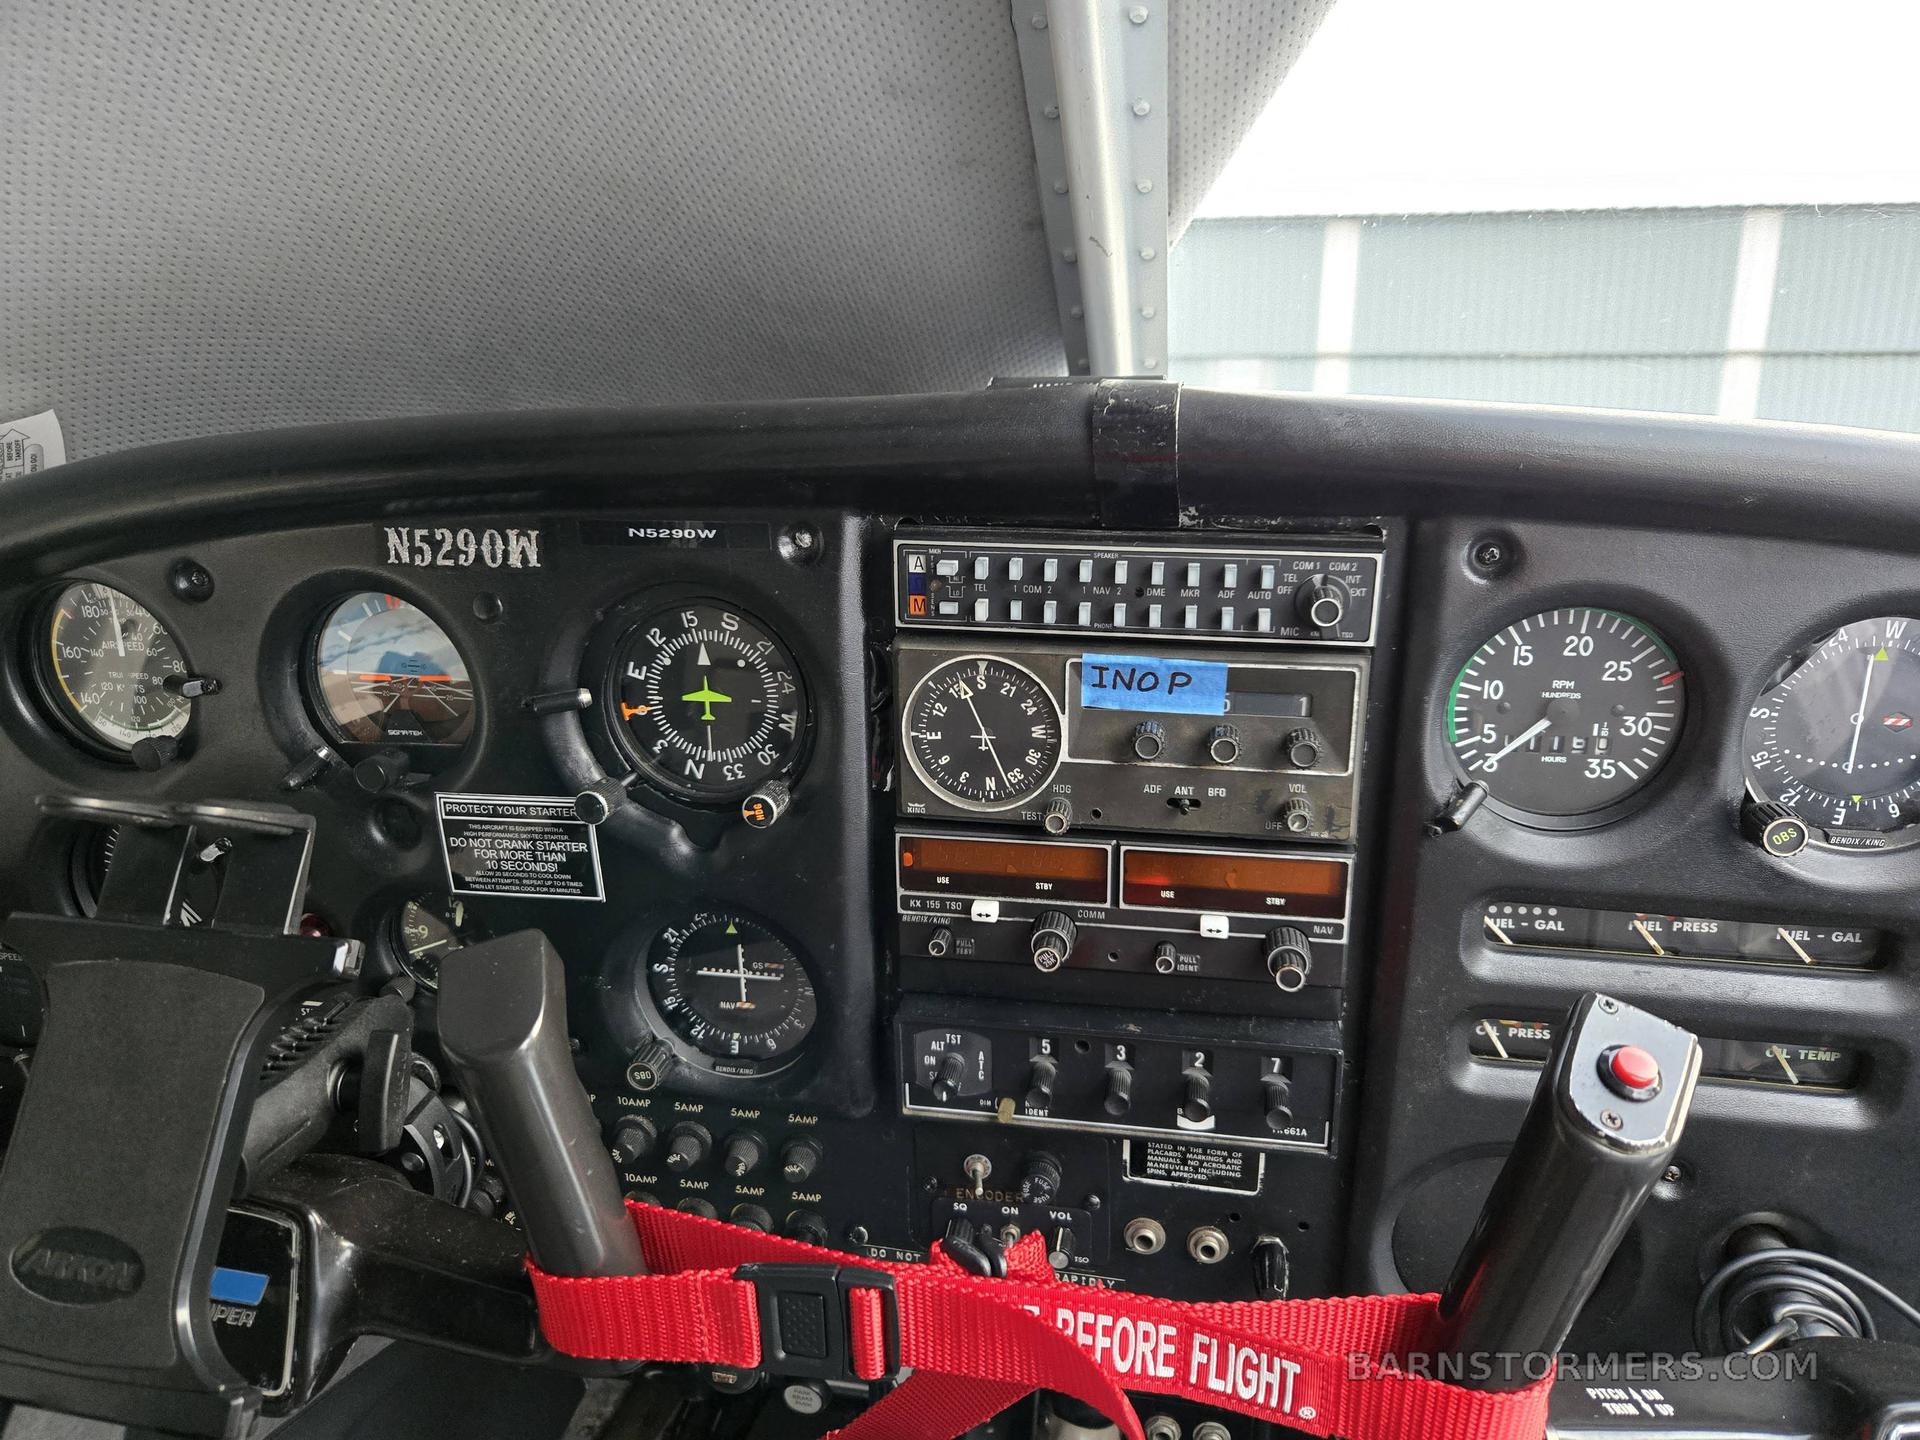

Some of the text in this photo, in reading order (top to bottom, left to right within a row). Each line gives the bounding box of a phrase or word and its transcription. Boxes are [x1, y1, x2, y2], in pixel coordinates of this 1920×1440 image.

[628, 527, 717, 539] N5290W
[384, 527, 541, 568] N5290W
[913, 557, 924, 571] A
[1293, 561, 1314, 570] COM
[1329, 562, 1357, 571] COM 2
[1283, 574, 1298, 582] TEL
[1345, 575, 1362, 584] INT
[974, 584, 988, 592] TEL
[1023, 585, 1042, 594] COM
[1047, 586, 1052, 594] 2
[1093, 587, 1111, 595] NAV
[1117, 587, 1122, 596] 2
[1146, 588, 1166, 597] DME
[1180, 589, 1200, 598] MKR
[1277, 586, 1293, 594] OFF
[1351, 588, 1367, 597] EXT
[1218, 590, 1235, 599] ADF
[1248, 591, 1271, 600] AUTO
[913, 598, 926, 612] M
[82, 606, 100, 618] 180
[680, 610, 698, 628] 15
[721, 612, 740, 631] S
[1280, 627, 1299, 636] MIC
[1885, 620, 1907, 640] W
[646, 628, 667, 648] 12
[756, 639, 775, 655] 21
[1563, 636, 1594, 656] 20
[62, 647, 81, 659] 160
[1513, 646, 1534, 666] 15
[627, 661, 647, 680] E
[1602, 661, 1633, 682] 25
[977, 676, 986, 689] S
[1091, 666, 1193, 695] INOP
[1552, 680, 1575, 690] RPM
[1000, 683, 1017, 698] 21
[1482, 680, 1504, 700] 10
[1541, 691, 1581, 700] HUNDREDS
[81, 692, 100, 704] 140
[932, 702, 948, 717] 12
[1020, 699, 1038, 716] 24
[1750, 707, 1770, 719] S
[778, 712, 798, 740] W
[1031, 725, 1046, 739] W
[1620, 716, 1653, 736] 30
[926, 731, 941, 740] E
[1482, 724, 1497, 743] 5
[1751, 751, 1772, 770] 15
[684, 758, 706, 779] N
[1584, 758, 1616, 779] 35
[1007, 768, 1025, 784] 33
[985, 777, 997, 790] N
[1053, 784, 1071, 794] HDG
[1143, 784, 1162, 794] ADF
[1288, 783, 1308, 794] VOL
[1174, 785, 1194, 796] ANT
[1208, 787, 1226, 797] BFO
[446, 804, 577, 817] PROTECT YOUR STARTER
[754, 803, 766, 821] HDG
[1021, 811, 1043, 820] TEST
[1831, 807, 1847, 826] E
[1265, 821, 1283, 831] OFF
[1772, 828, 1798, 846] OBS
[1830, 836, 1886, 848] BENDIX/KING
[450, 838, 588, 852] DO NOT CRANK STARTER
[474, 849, 567, 862] FOR MORE THAN
[486, 860, 558, 873] 10 SECONDS!
[937, 876, 950, 884] USE
[1035, 882, 1053, 891] STBY
[1160, 890, 1175, 899] USE
[909, 899, 962, 910] KX 155 TSO
[1266, 897, 1286, 906] STBY
[1078, 909, 1105, 920] COMM
[1313, 925, 1333, 935] NAV
[1534, 919, 1565, 931] GAL
[1673, 921, 1718, 933] PRESS
[1831, 931, 1862, 943] GAL
[1177, 964, 1198, 972] IDENT
[720, 1001, 735, 1009] NAV
[946, 1033, 962, 1045] TST
[1508, 1028, 1551, 1040] PRESS
[931, 1041, 945, 1051] ALT
[1041, 1039, 1051, 1054] 5
[1117, 1045, 1126, 1060] 3
[1799, 1049, 1842, 1062] TEMP
[924, 1056, 936, 1065] ON
[1194, 1052, 1206, 1067] 2
[1271, 1057, 1281, 1073] 7
[617, 1096, 651, 1108] 10AMP
[674, 1101, 704, 1113] 5AMP
[731, 1107, 761, 1119] 5AMP
[1025, 1107, 1049, 1117] IDENT
[788, 1113, 818, 1125] 5AMP
[1147, 1142, 1173, 1150] STATED
[1207, 1148, 1228, 1156] FORM
[1186, 1153, 1223, 1162] MARKINGS
[1203, 1161, 1241, 1171] ACROBATIC
[624, 1172, 658, 1184] 10AMP
[1198, 1167, 1241, 1178] INCLUDING
[680, 1178, 710, 1190] 5AMP
[735, 1184, 765, 1196] 5AMP
[791, 1191, 822, 1203] 5AMP
[953, 1202, 968, 1212] SQ
[1001, 1206, 1019, 1216] ON
[1049, 1211, 1072, 1221] VOL
[870, 1248, 921, 1262] DO NOT
[1189, 1332, 1301, 1414] FLIGHT
[1586, 1387, 1629, 1399] PITCH
[1602, 1402, 1675, 1416] TRIM UP
